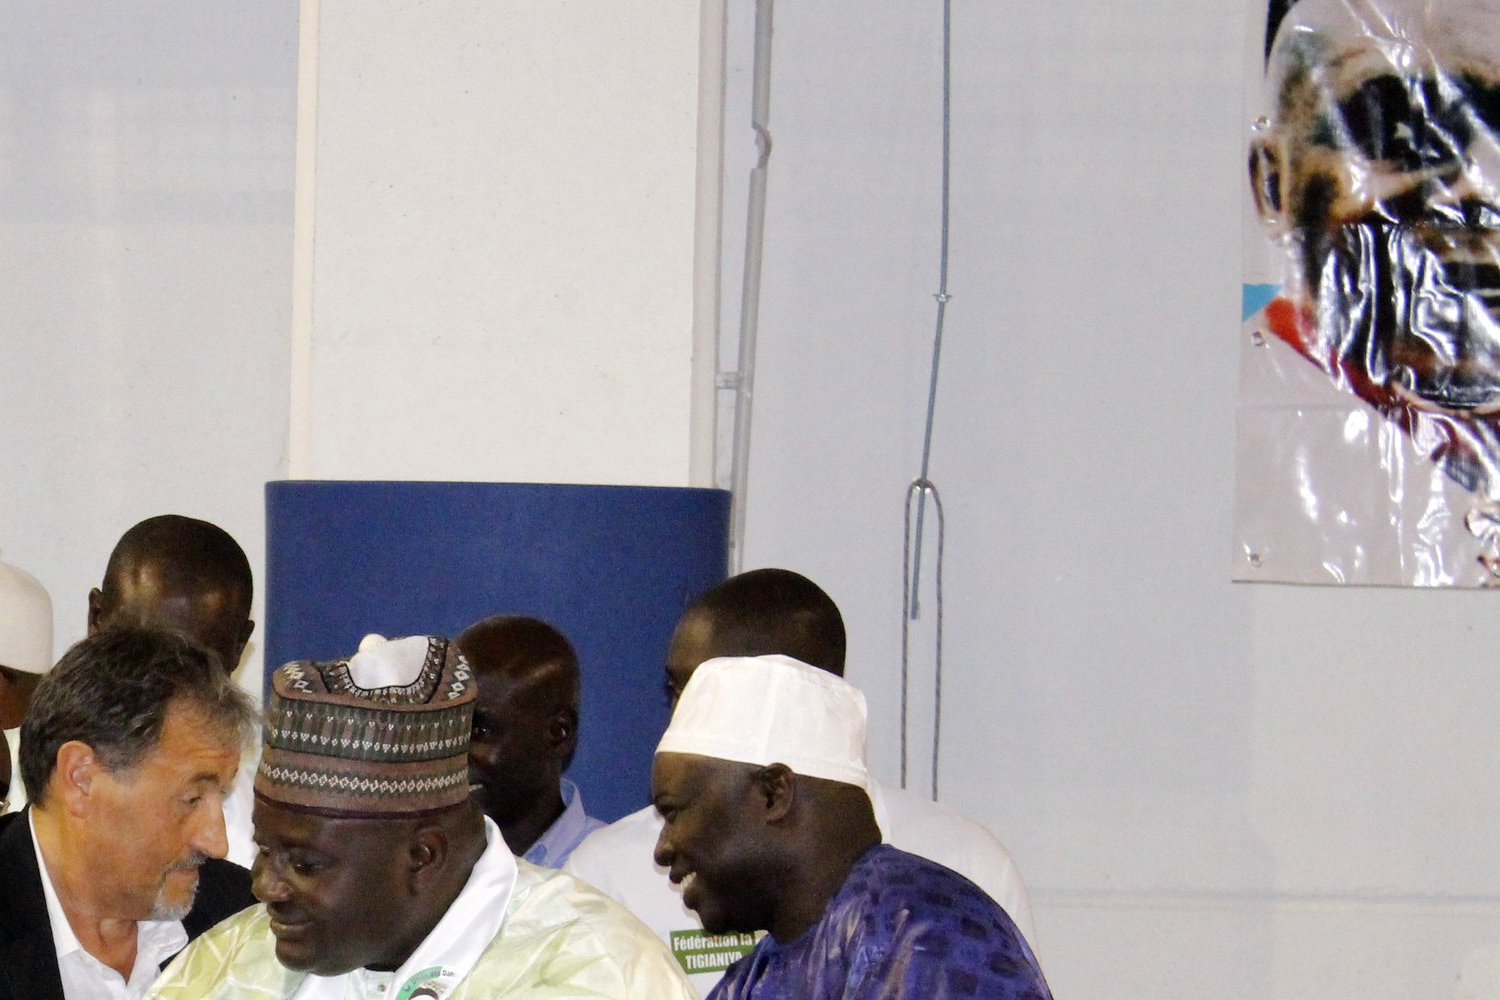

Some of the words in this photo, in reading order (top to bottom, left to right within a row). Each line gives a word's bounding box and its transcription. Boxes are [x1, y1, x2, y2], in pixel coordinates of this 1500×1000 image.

[673, 934, 738, 951] Fédération
[739, 933, 753, 946] la
[685, 951, 743, 969] TIGIANIYA
